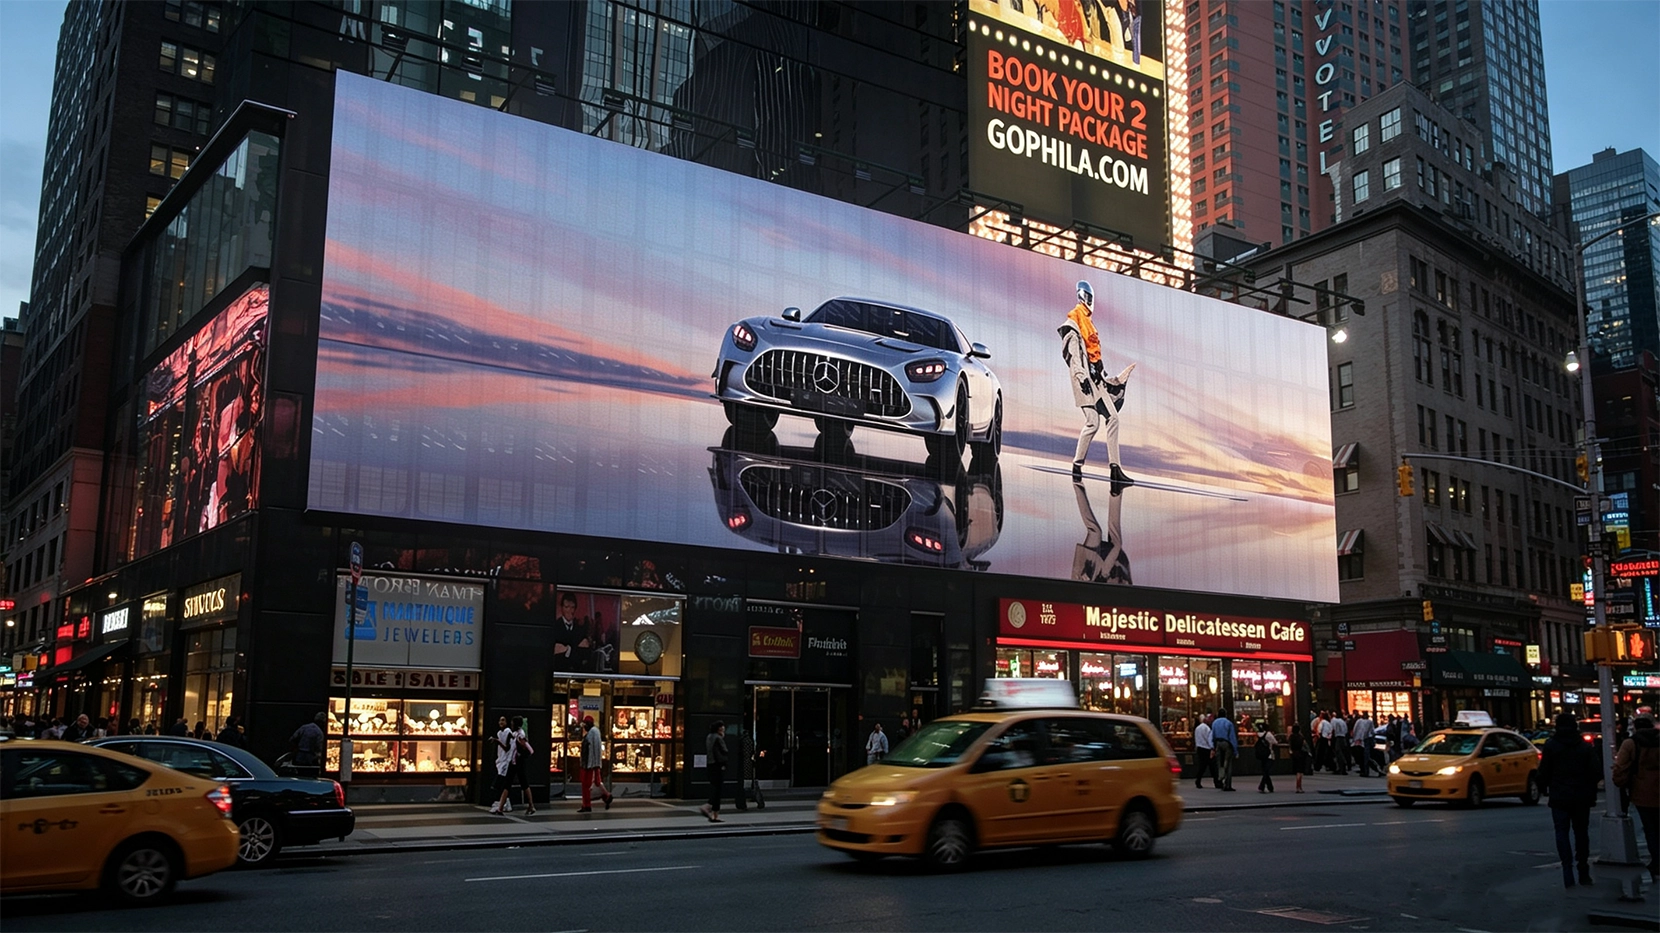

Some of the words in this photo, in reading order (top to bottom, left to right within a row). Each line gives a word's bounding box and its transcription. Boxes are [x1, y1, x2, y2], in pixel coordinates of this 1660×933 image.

[988, 49, 1058, 100] BOOK
[1061, 75, 1125, 123] YOUR
[1130, 99, 1147, 131] 2
[988, 81, 1053, 127] NIGHT
[1058, 105, 1148, 160] PACKAGE
[987, 118, 1149, 195] GOPHILA.COM
[1086, 606, 1159, 633] Majestic
[1165, 613, 1266, 640] Delicatessen
[1270, 621, 1305, 642] Cafe
[409, 672, 458, 688] SALE
